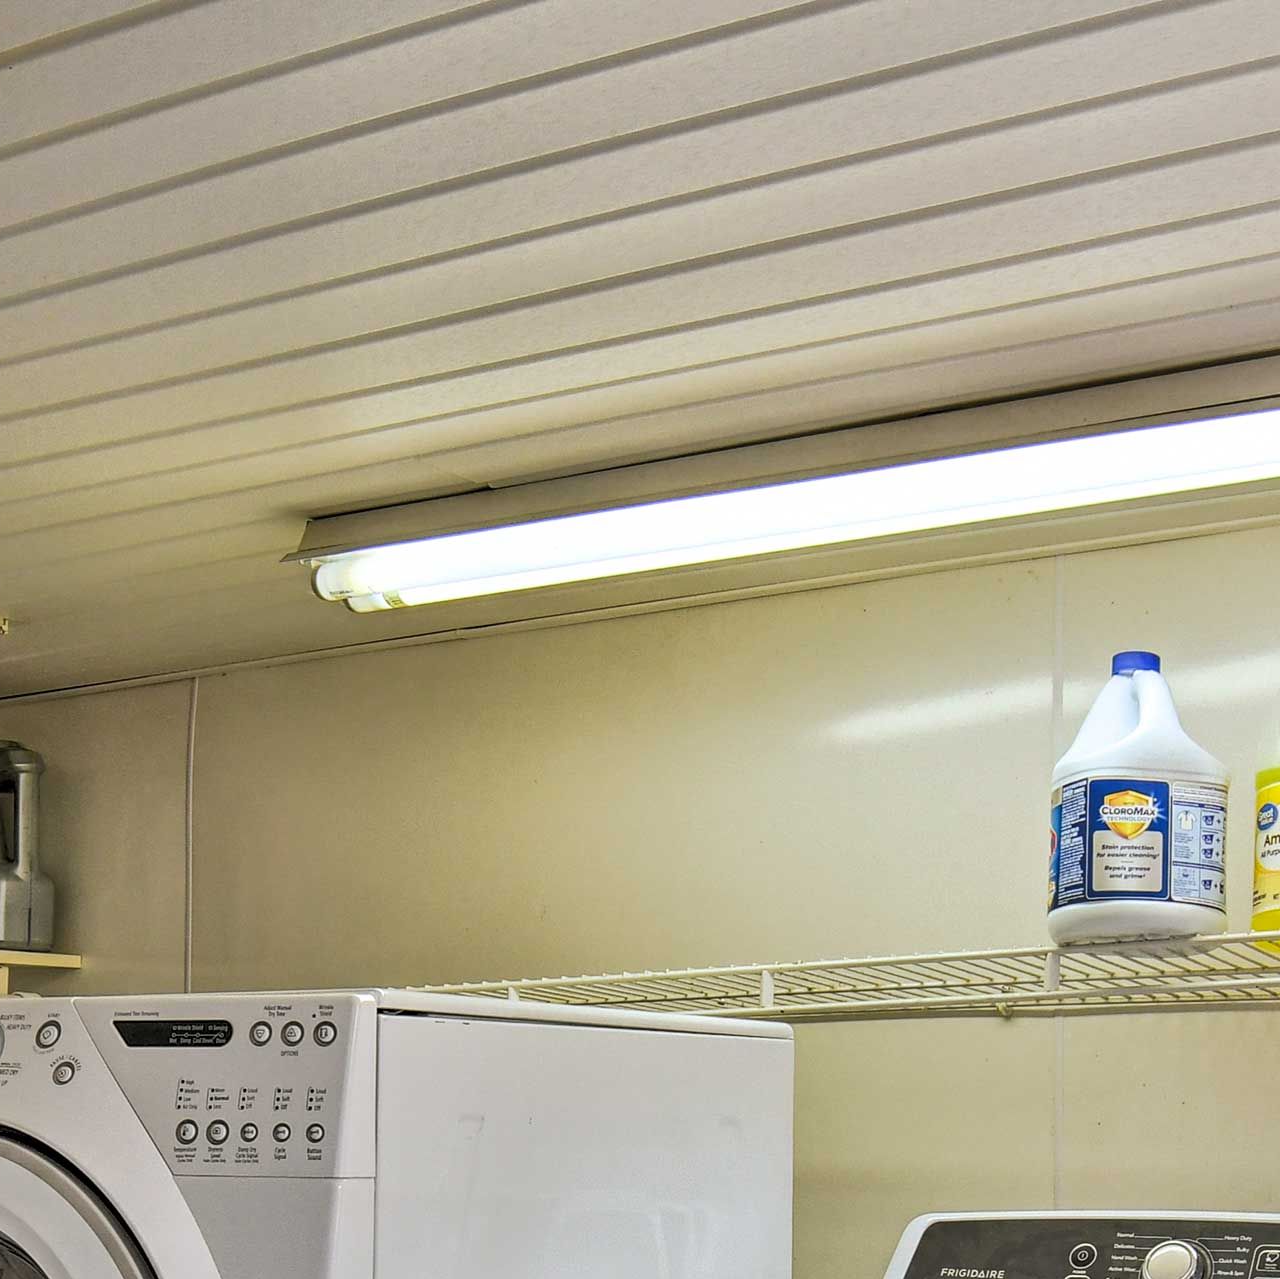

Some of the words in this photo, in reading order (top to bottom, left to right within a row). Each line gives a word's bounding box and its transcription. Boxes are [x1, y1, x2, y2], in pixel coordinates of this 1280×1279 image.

[1127, 865, 1151, 873] grease
[1218, 1257, 1233, 1265] Quick
[939, 1267, 1006, 1279] FRIGIDAIRE
